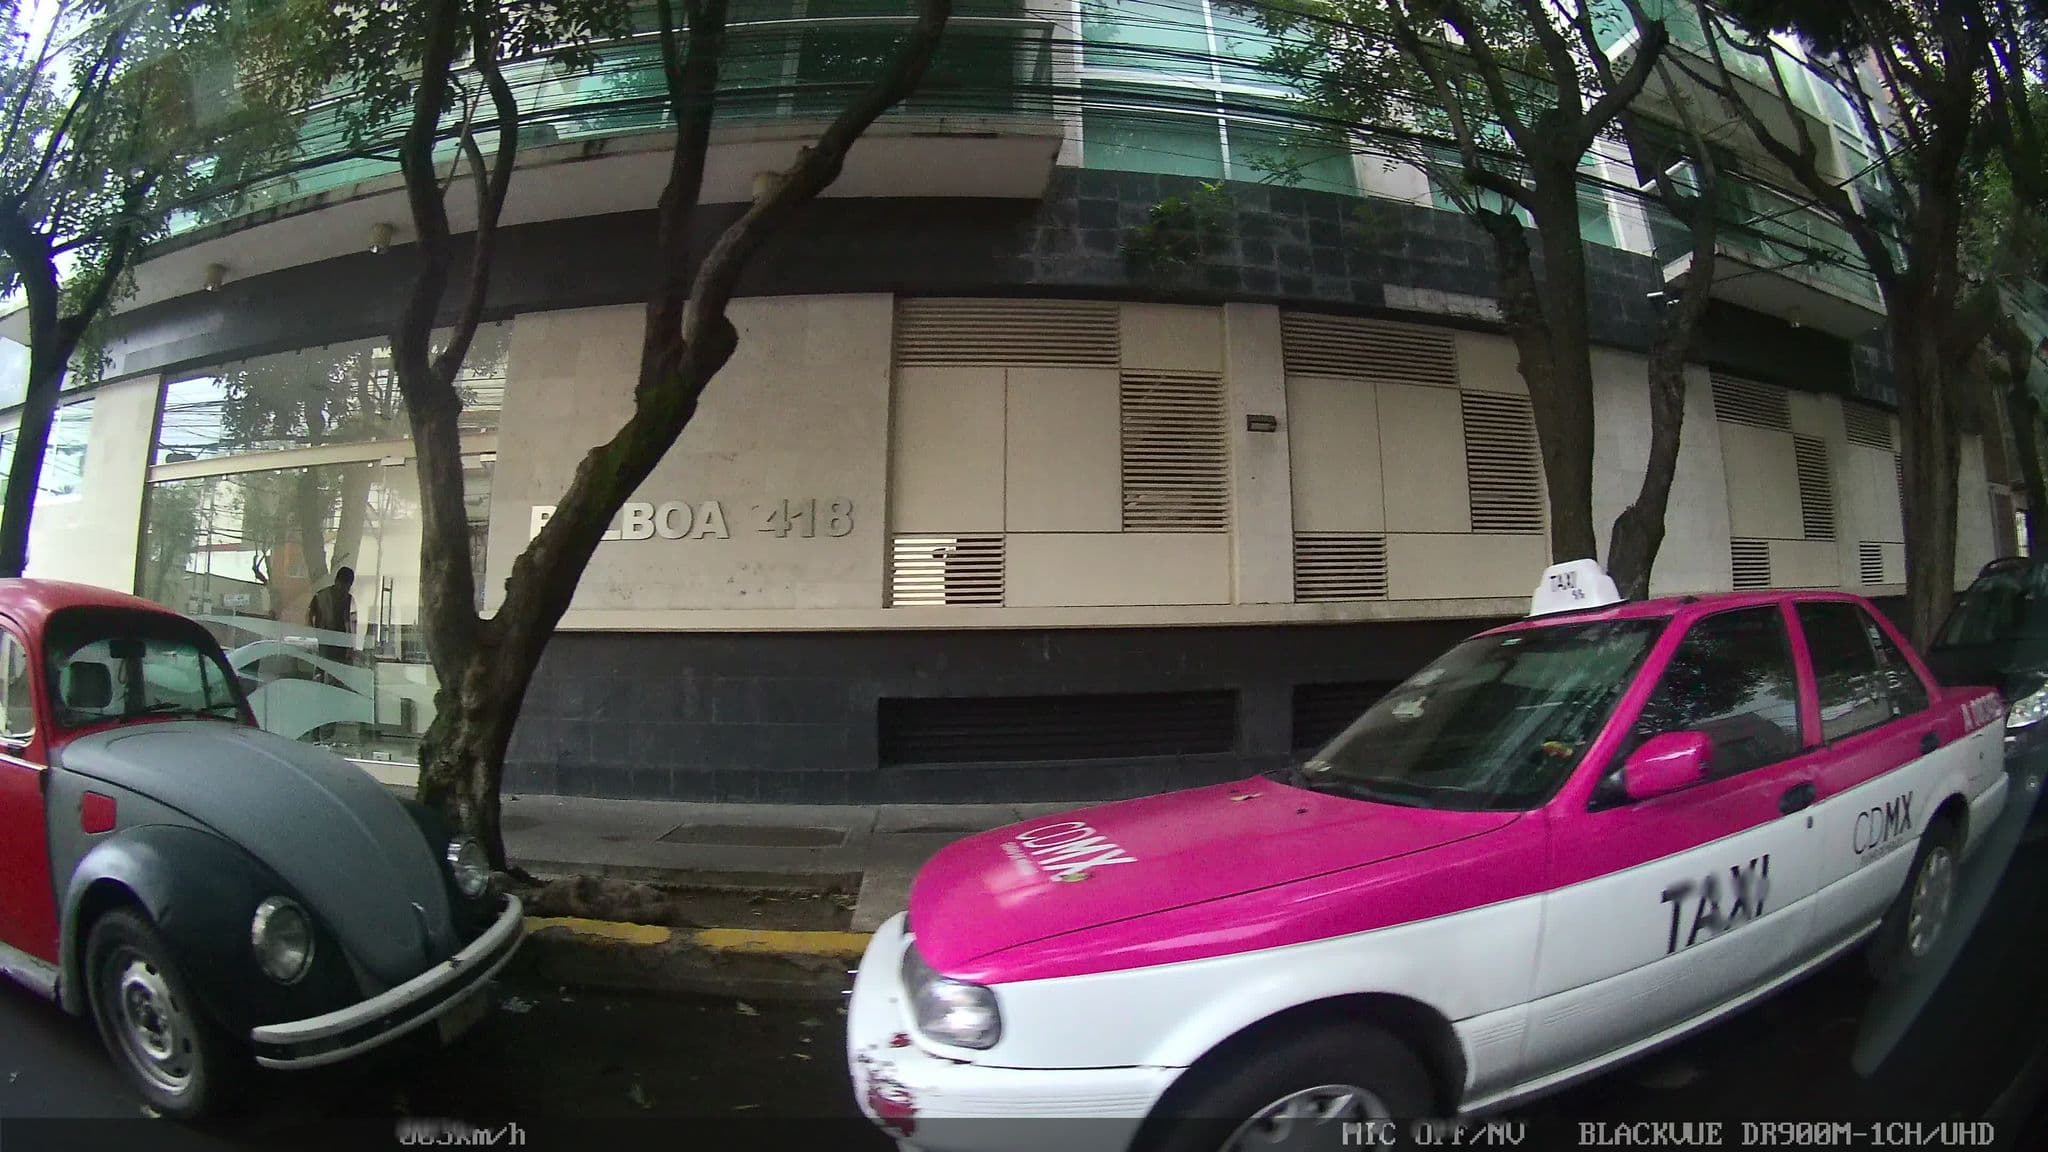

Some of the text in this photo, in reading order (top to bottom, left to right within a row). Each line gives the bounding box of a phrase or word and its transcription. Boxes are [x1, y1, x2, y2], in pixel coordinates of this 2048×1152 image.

[529, 498, 854, 541] BBOA 418
[1015, 821, 1138, 882] CDMX
[1852, 790, 1914, 855] CDMX
[1660, 853, 1770, 955] TAXI
